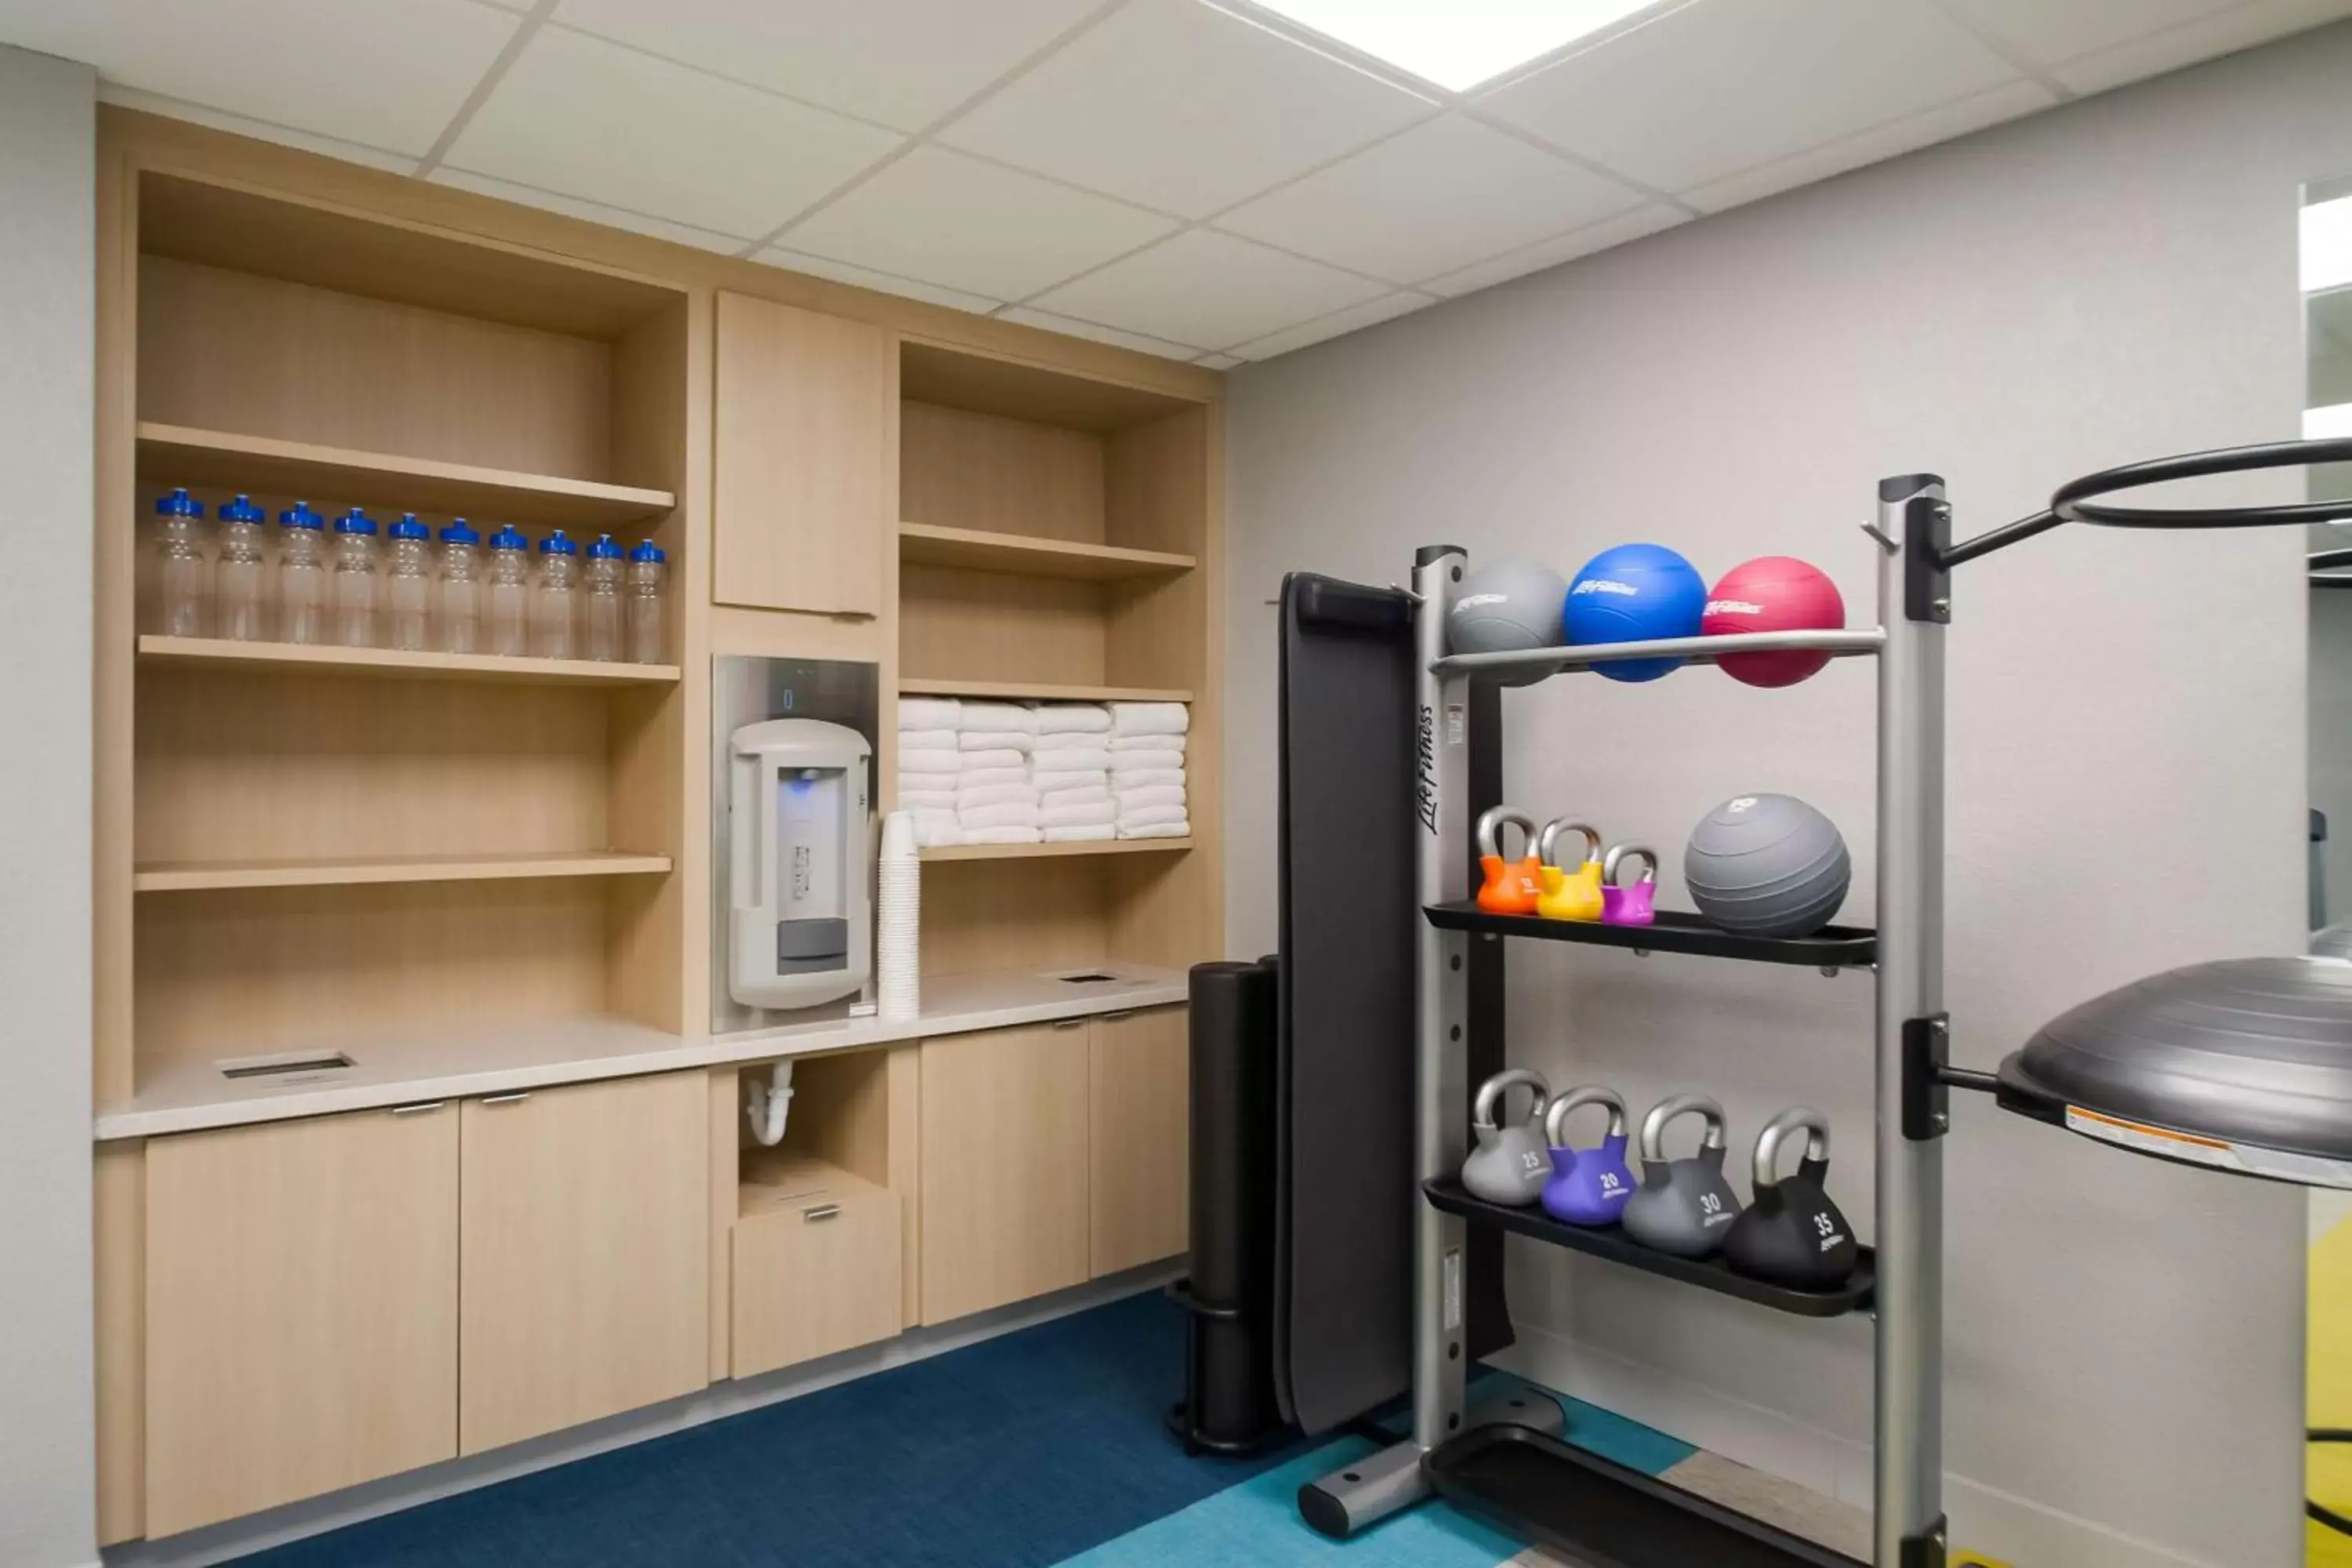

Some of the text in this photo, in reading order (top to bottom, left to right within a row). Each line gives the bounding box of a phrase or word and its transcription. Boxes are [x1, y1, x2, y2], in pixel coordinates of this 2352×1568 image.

[1599, 1172, 1619, 1189] 20
[1700, 1192, 1722, 1214] 30
[1814, 1212, 1835, 1236] 35
